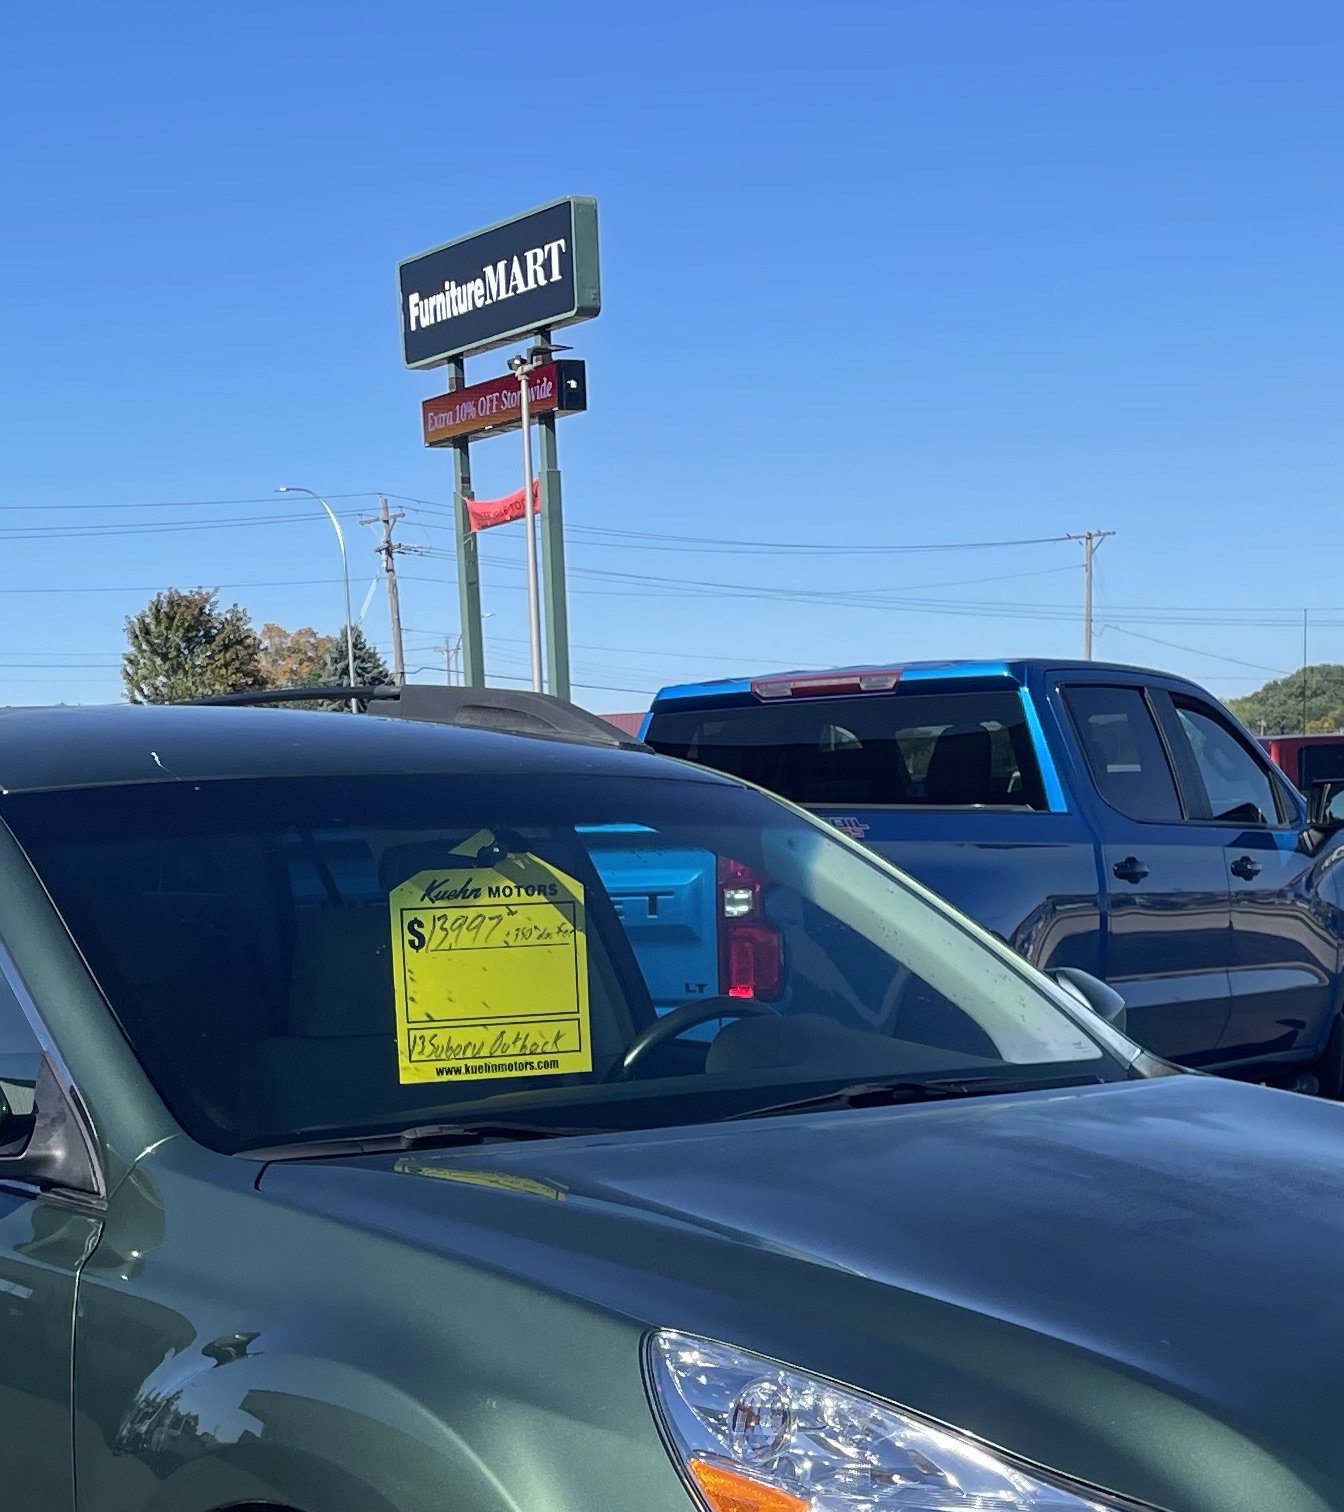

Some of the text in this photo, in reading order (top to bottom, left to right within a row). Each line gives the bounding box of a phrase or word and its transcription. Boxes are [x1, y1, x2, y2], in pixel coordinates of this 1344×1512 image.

[408, 238, 566, 331] FurnitureMART
[428, 377, 553, 432] Extra 10% OFF Storwide
[420, 877, 558, 903] Kuehn MOTORS
[684, 983, 708, 993] LT
[435, 1059, 560, 1077] www.kuehnmotors.com
